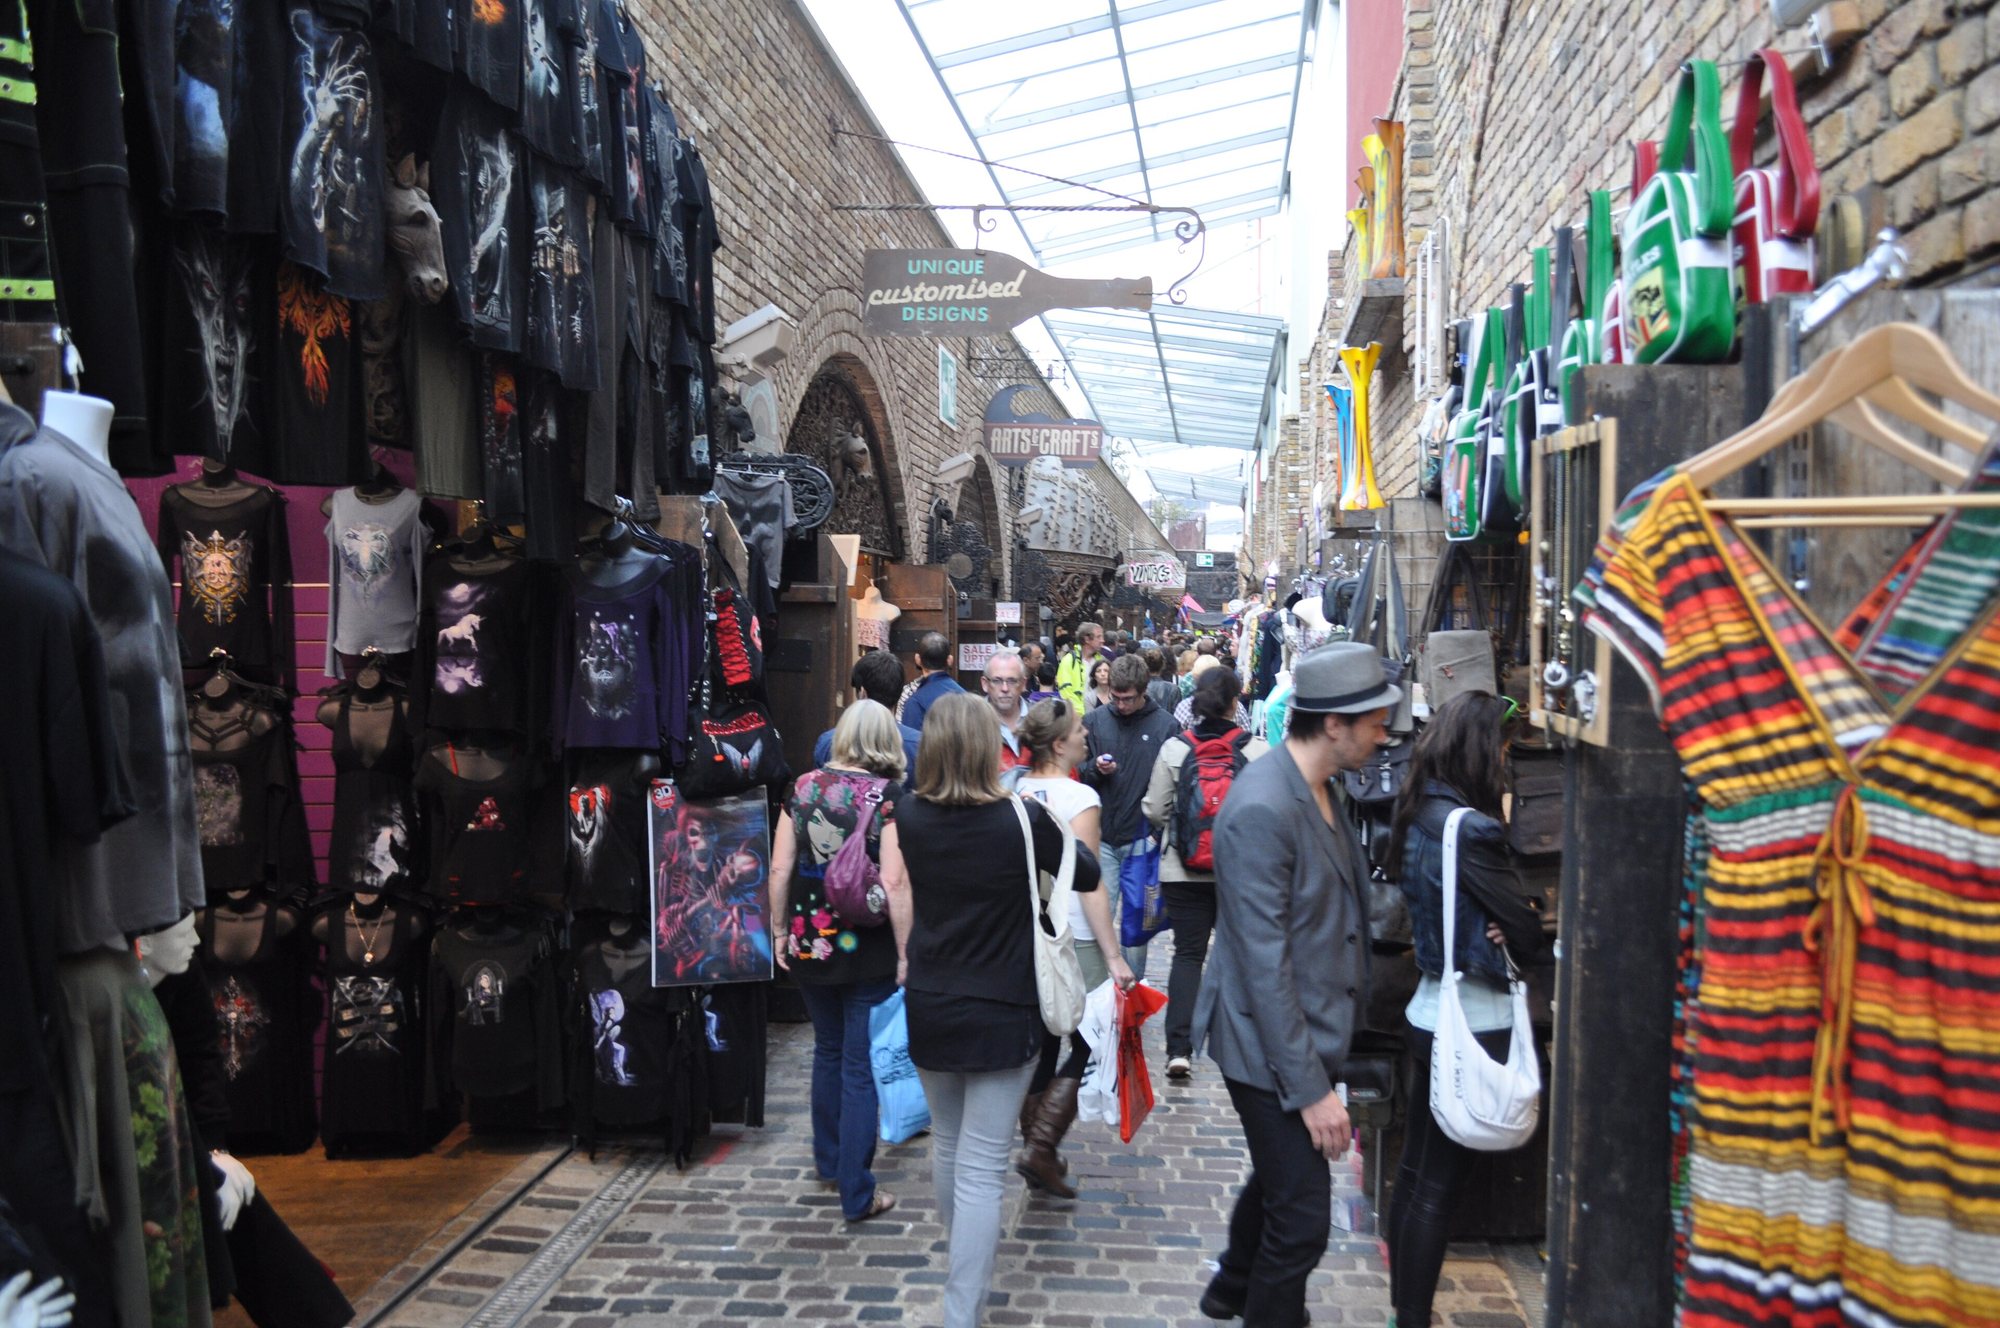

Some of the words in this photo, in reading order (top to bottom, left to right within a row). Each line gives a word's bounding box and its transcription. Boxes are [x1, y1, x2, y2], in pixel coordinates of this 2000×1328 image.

[907, 259, 985, 275] UNIQUE
[865, 269, 1027, 310] customised
[902, 306, 989, 322] DESIGNS
[963, 645, 992, 654] SALE
[654, 785, 672, 800] 3D
